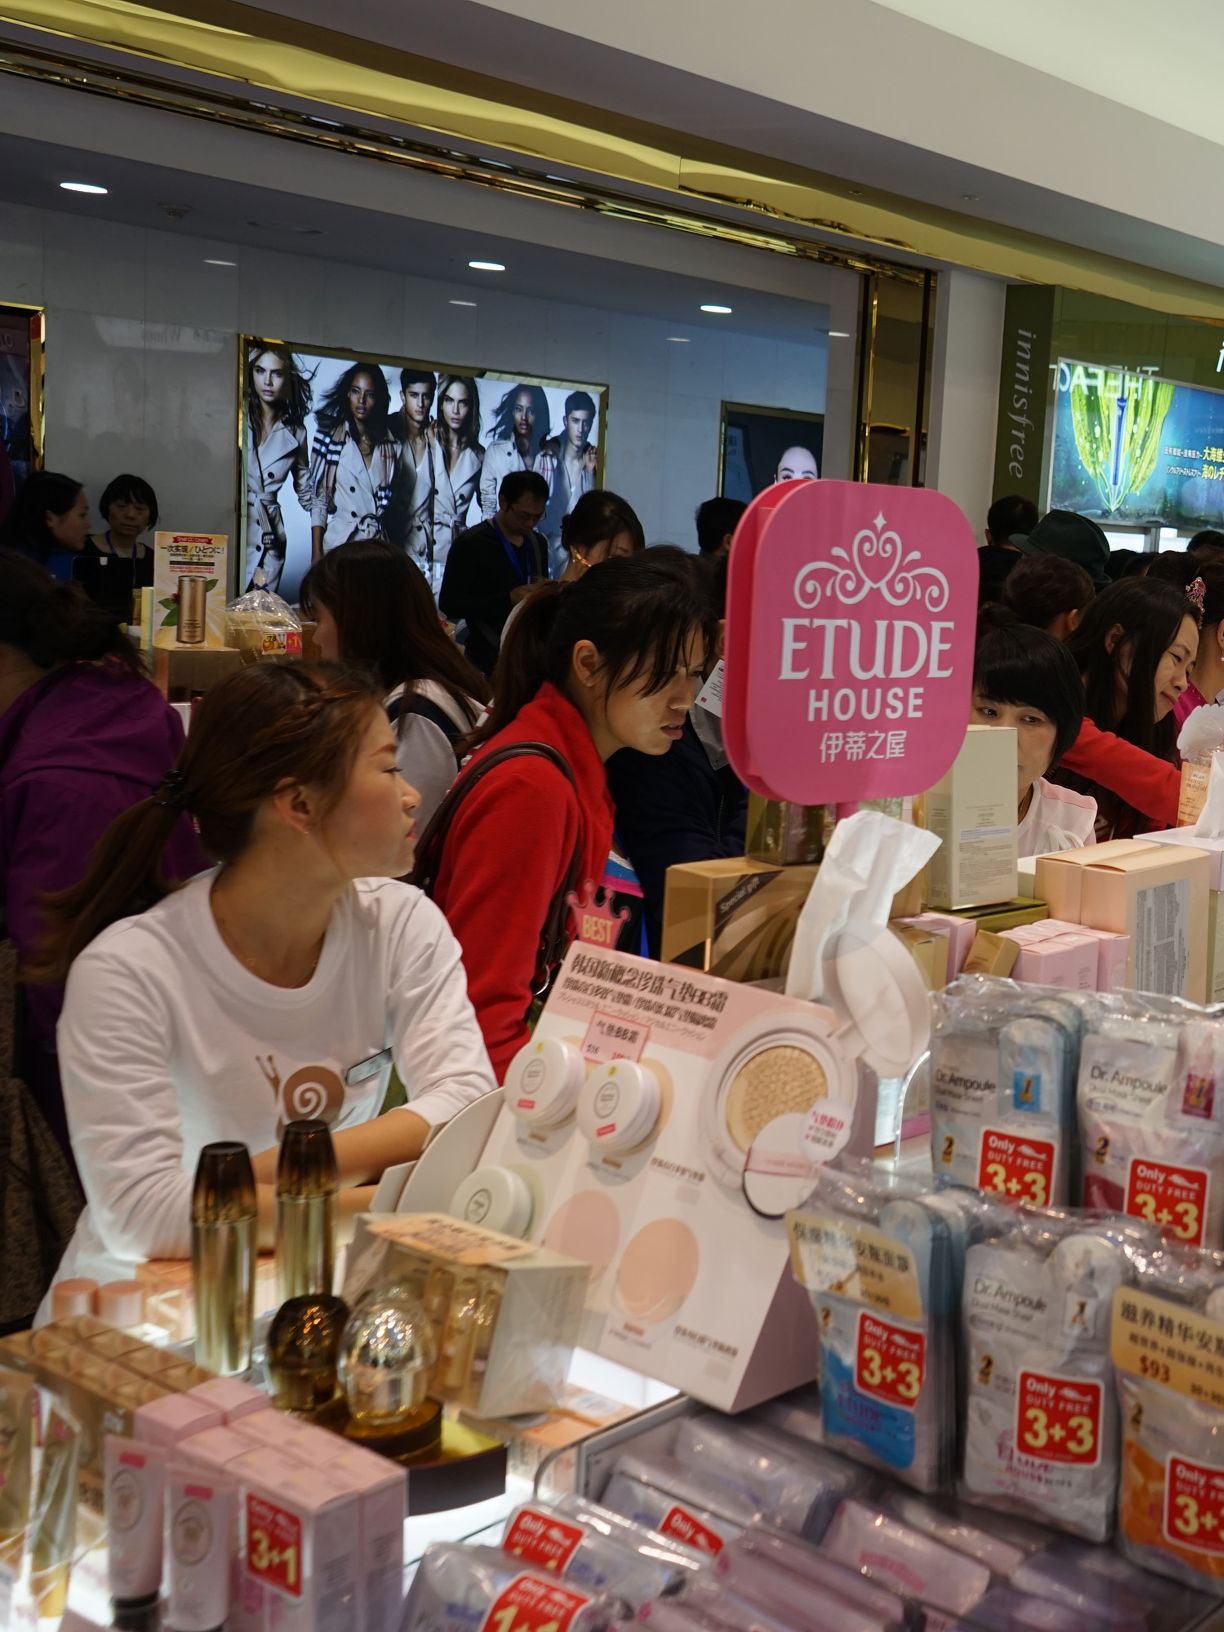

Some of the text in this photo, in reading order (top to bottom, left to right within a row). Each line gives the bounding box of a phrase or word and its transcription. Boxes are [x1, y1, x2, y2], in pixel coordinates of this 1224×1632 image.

[1008, 327, 1037, 480] innisfree
[777, 618, 955, 681] ETUDE
[808, 687, 924, 722] HOUSE
[820, 730, 907, 763] 伊蒂之屋
[719, 888, 746, 914] Special
[582, 914, 614, 944] BEST
[935, 1067, 996, 1093] Dr. Ampoule
[1091, 1065, 1167, 1094] Dr. Ampoule
[988, 1135, 1016, 1155] Only
[984, 1163, 1046, 1206] 3+3
[1136, 1164, 1166, 1183] Only
[1131, 1193, 1199, 1239] 3+3
[974, 1278, 1047, 1314] Dr. Ampoule
[863, 1320, 888, 1342] Only
[861, 1349, 920, 1398] 3+3
[1139, 1354, 1170, 1384] $93
[1026, 1377, 1056, 1398] Only
[1023, 1408, 1094, 1454] 3+3
[1176, 1464, 1206, 1487] Only
[251, 1529, 297, 1586] 3+1
